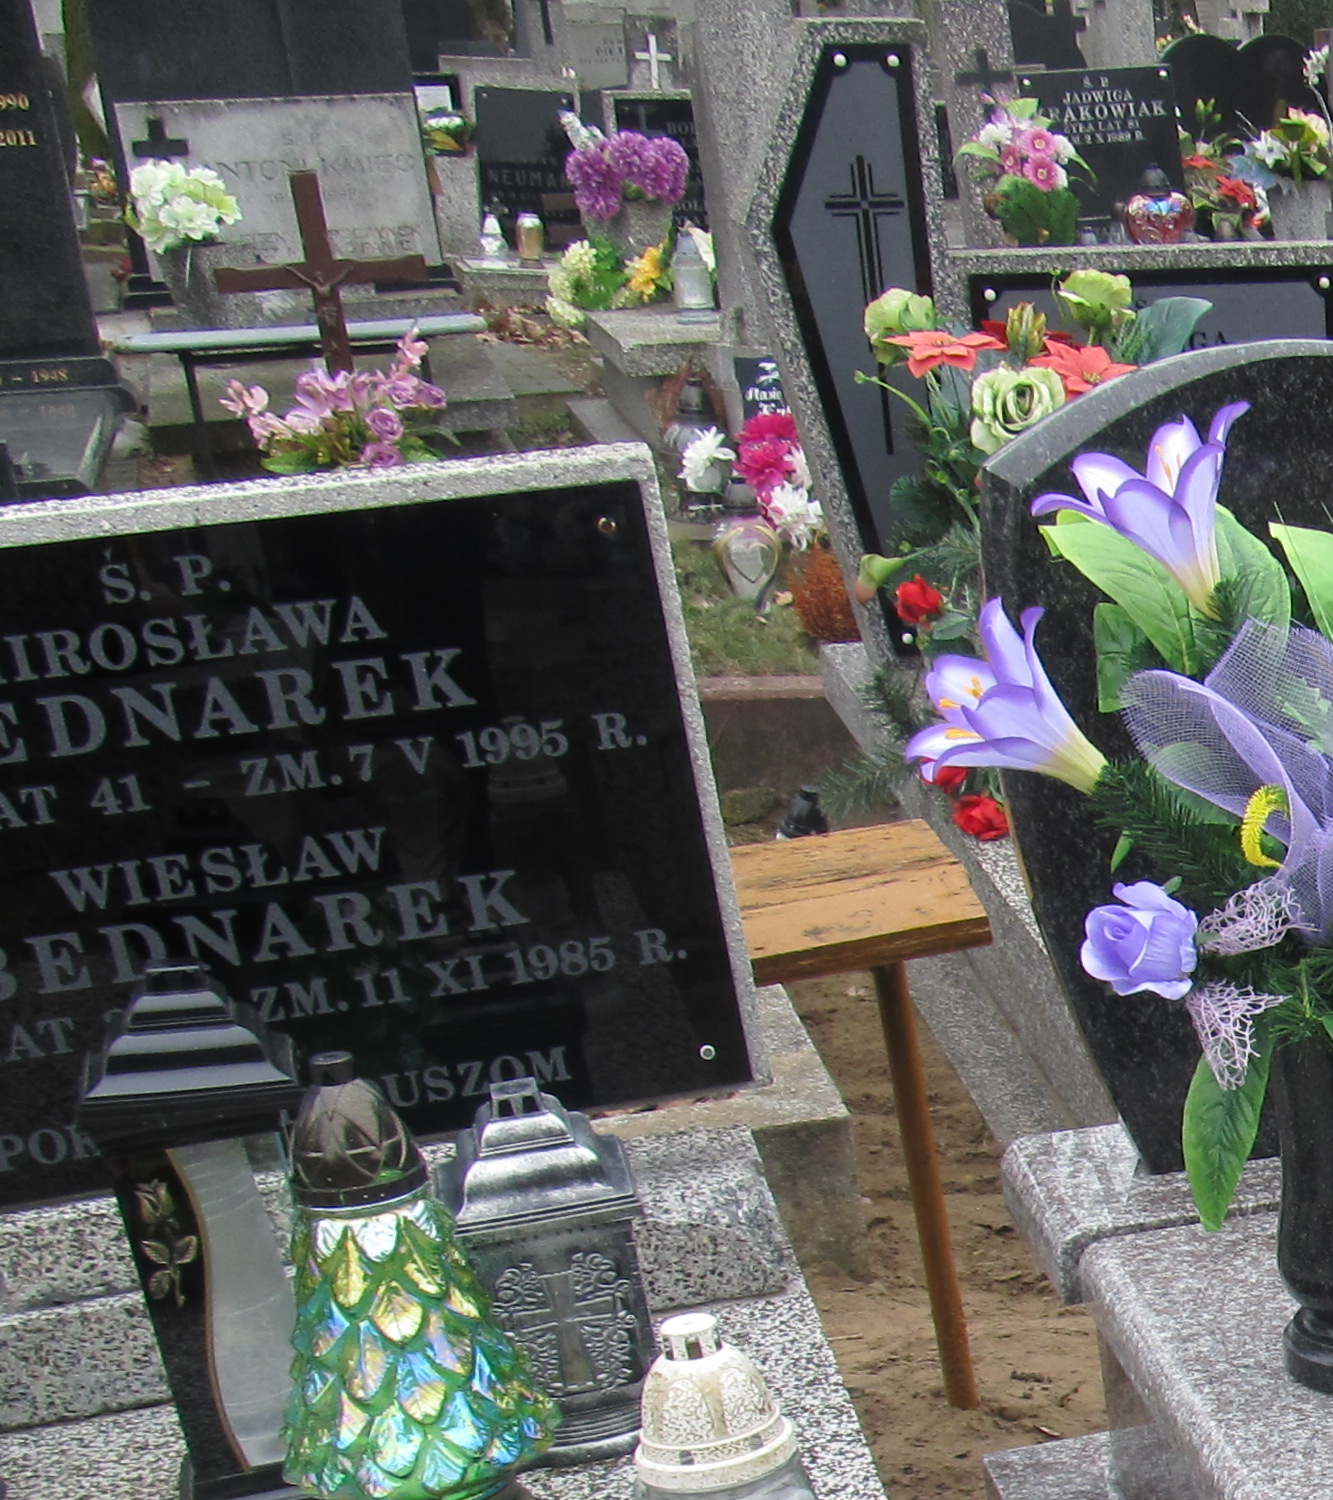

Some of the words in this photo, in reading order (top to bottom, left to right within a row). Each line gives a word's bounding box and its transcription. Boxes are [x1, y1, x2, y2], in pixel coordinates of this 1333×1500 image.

[1038, 99, 1168, 123] RAKOWIAK
[1062, 89, 1134, 105] JADWIGA
[1099, 119, 1122, 131] LAT
[99, 548, 152, 604] Ś.
[173, 554, 232, 597] P.
[0, 595, 388, 685] IROSŁAWA
[90, 773, 152, 816] 41
[395, 736, 435, 775] V
[455, 718, 570, 769] 1995
[591, 711, 648, 752] R.
[48, 825, 387, 913] WIESŁAW
[427, 954, 491, 998] XI
[505, 936, 616, 986] 1985
[632, 928, 688, 966] R.
[380, 1045, 574, 1108] USZOM
